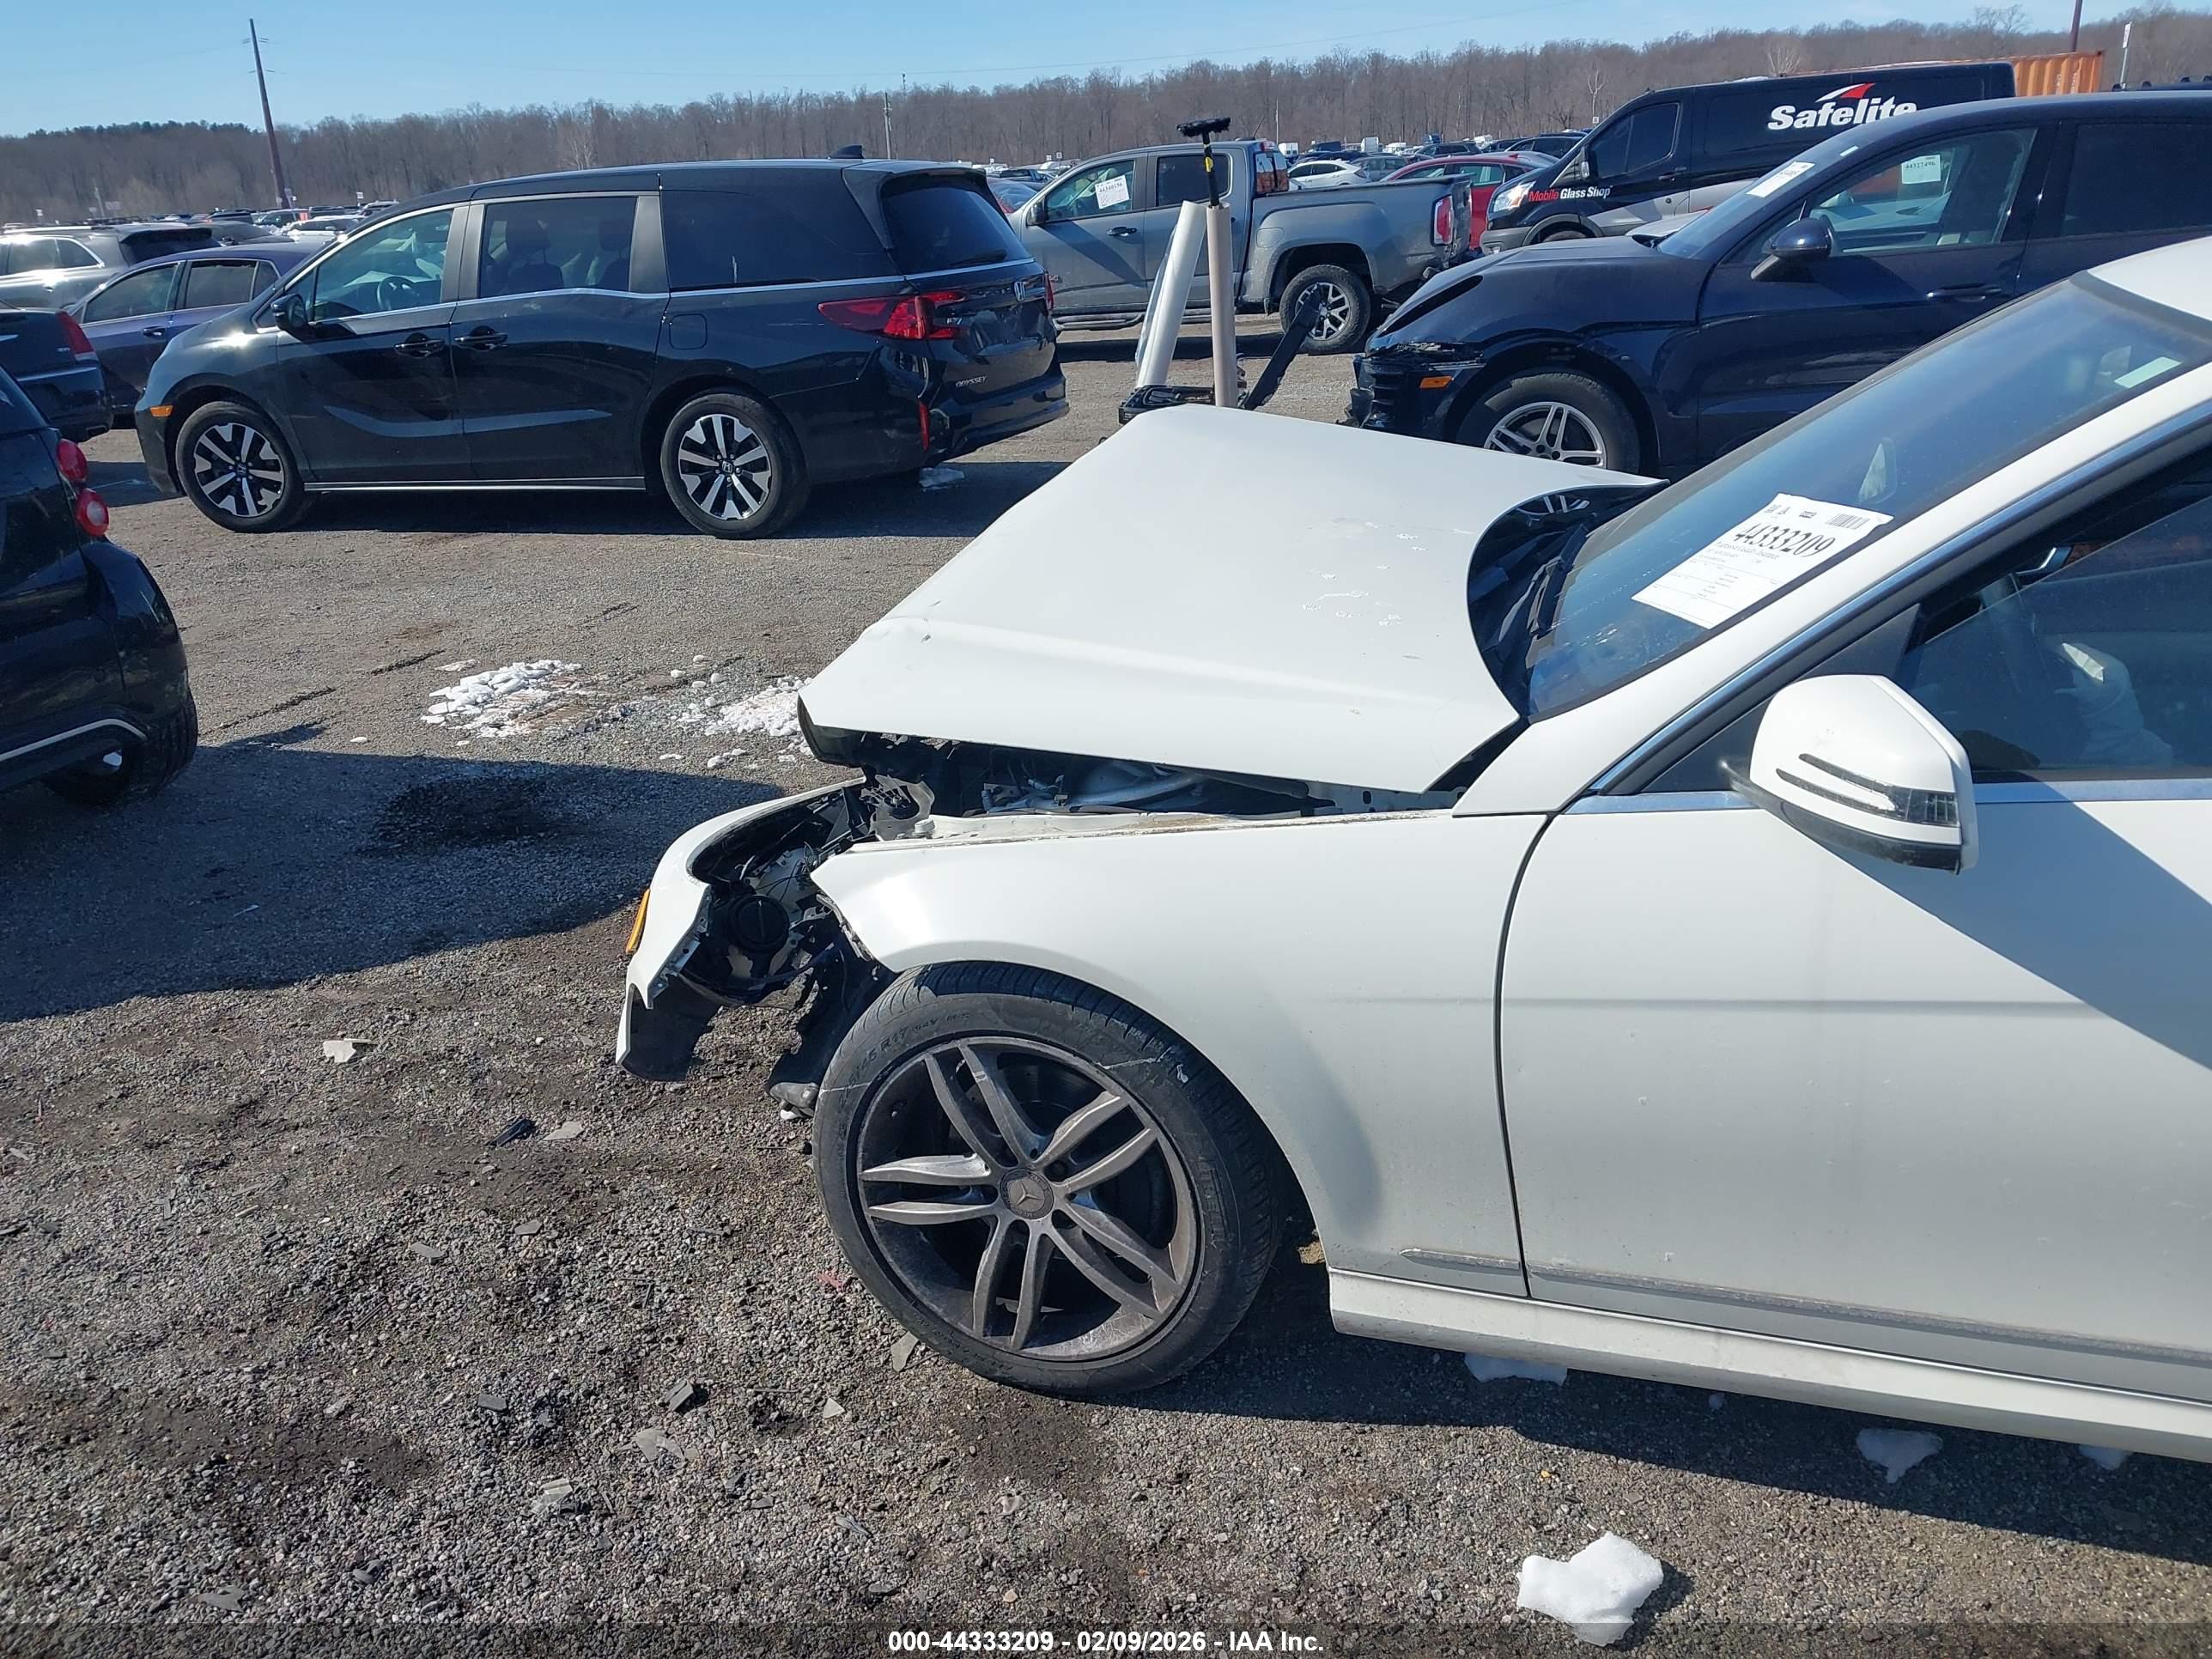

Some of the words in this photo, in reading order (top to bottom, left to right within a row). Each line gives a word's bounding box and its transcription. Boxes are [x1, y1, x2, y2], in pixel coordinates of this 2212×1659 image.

[1767, 96, 1917, 131] Safelite
[1528, 190, 1559, 202] Mobile
[1559, 188, 1586, 199] Glass
[955, 375, 987, 388] ODYSSEY
[1734, 522, 1836, 557] 44333209
